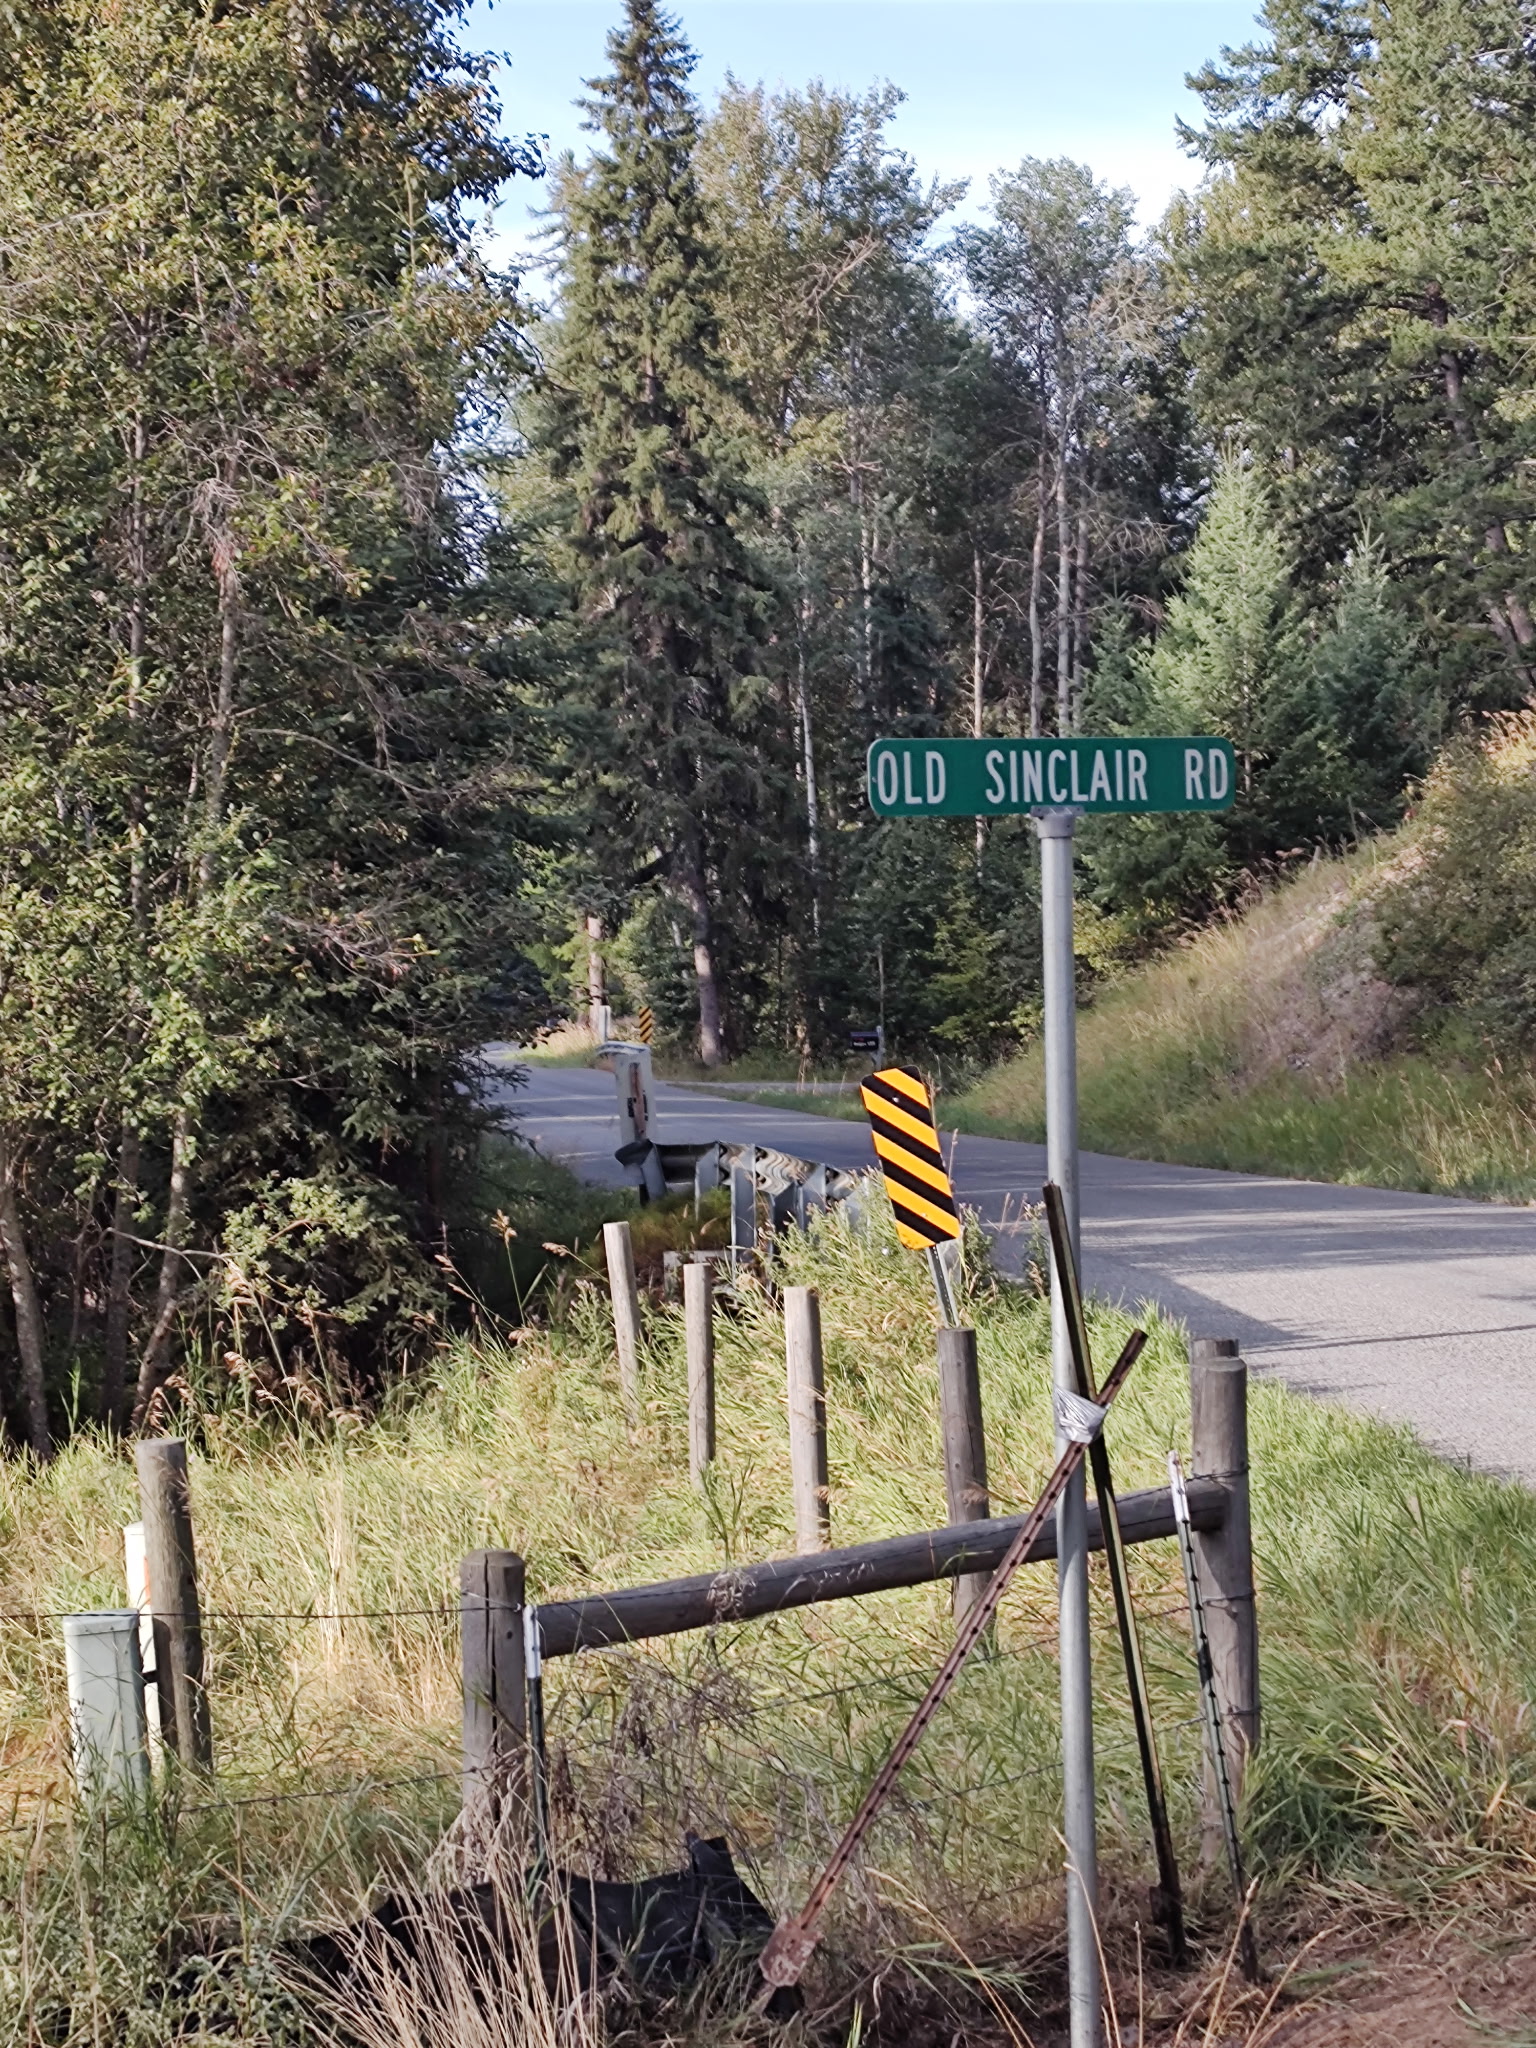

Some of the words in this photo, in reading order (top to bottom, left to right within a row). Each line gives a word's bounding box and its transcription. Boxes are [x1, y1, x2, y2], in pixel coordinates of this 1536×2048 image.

[877, 751, 946, 805] OLD
[985, 749, 1148, 803] SINCLAIR
[1184, 748, 1229, 800] RD
